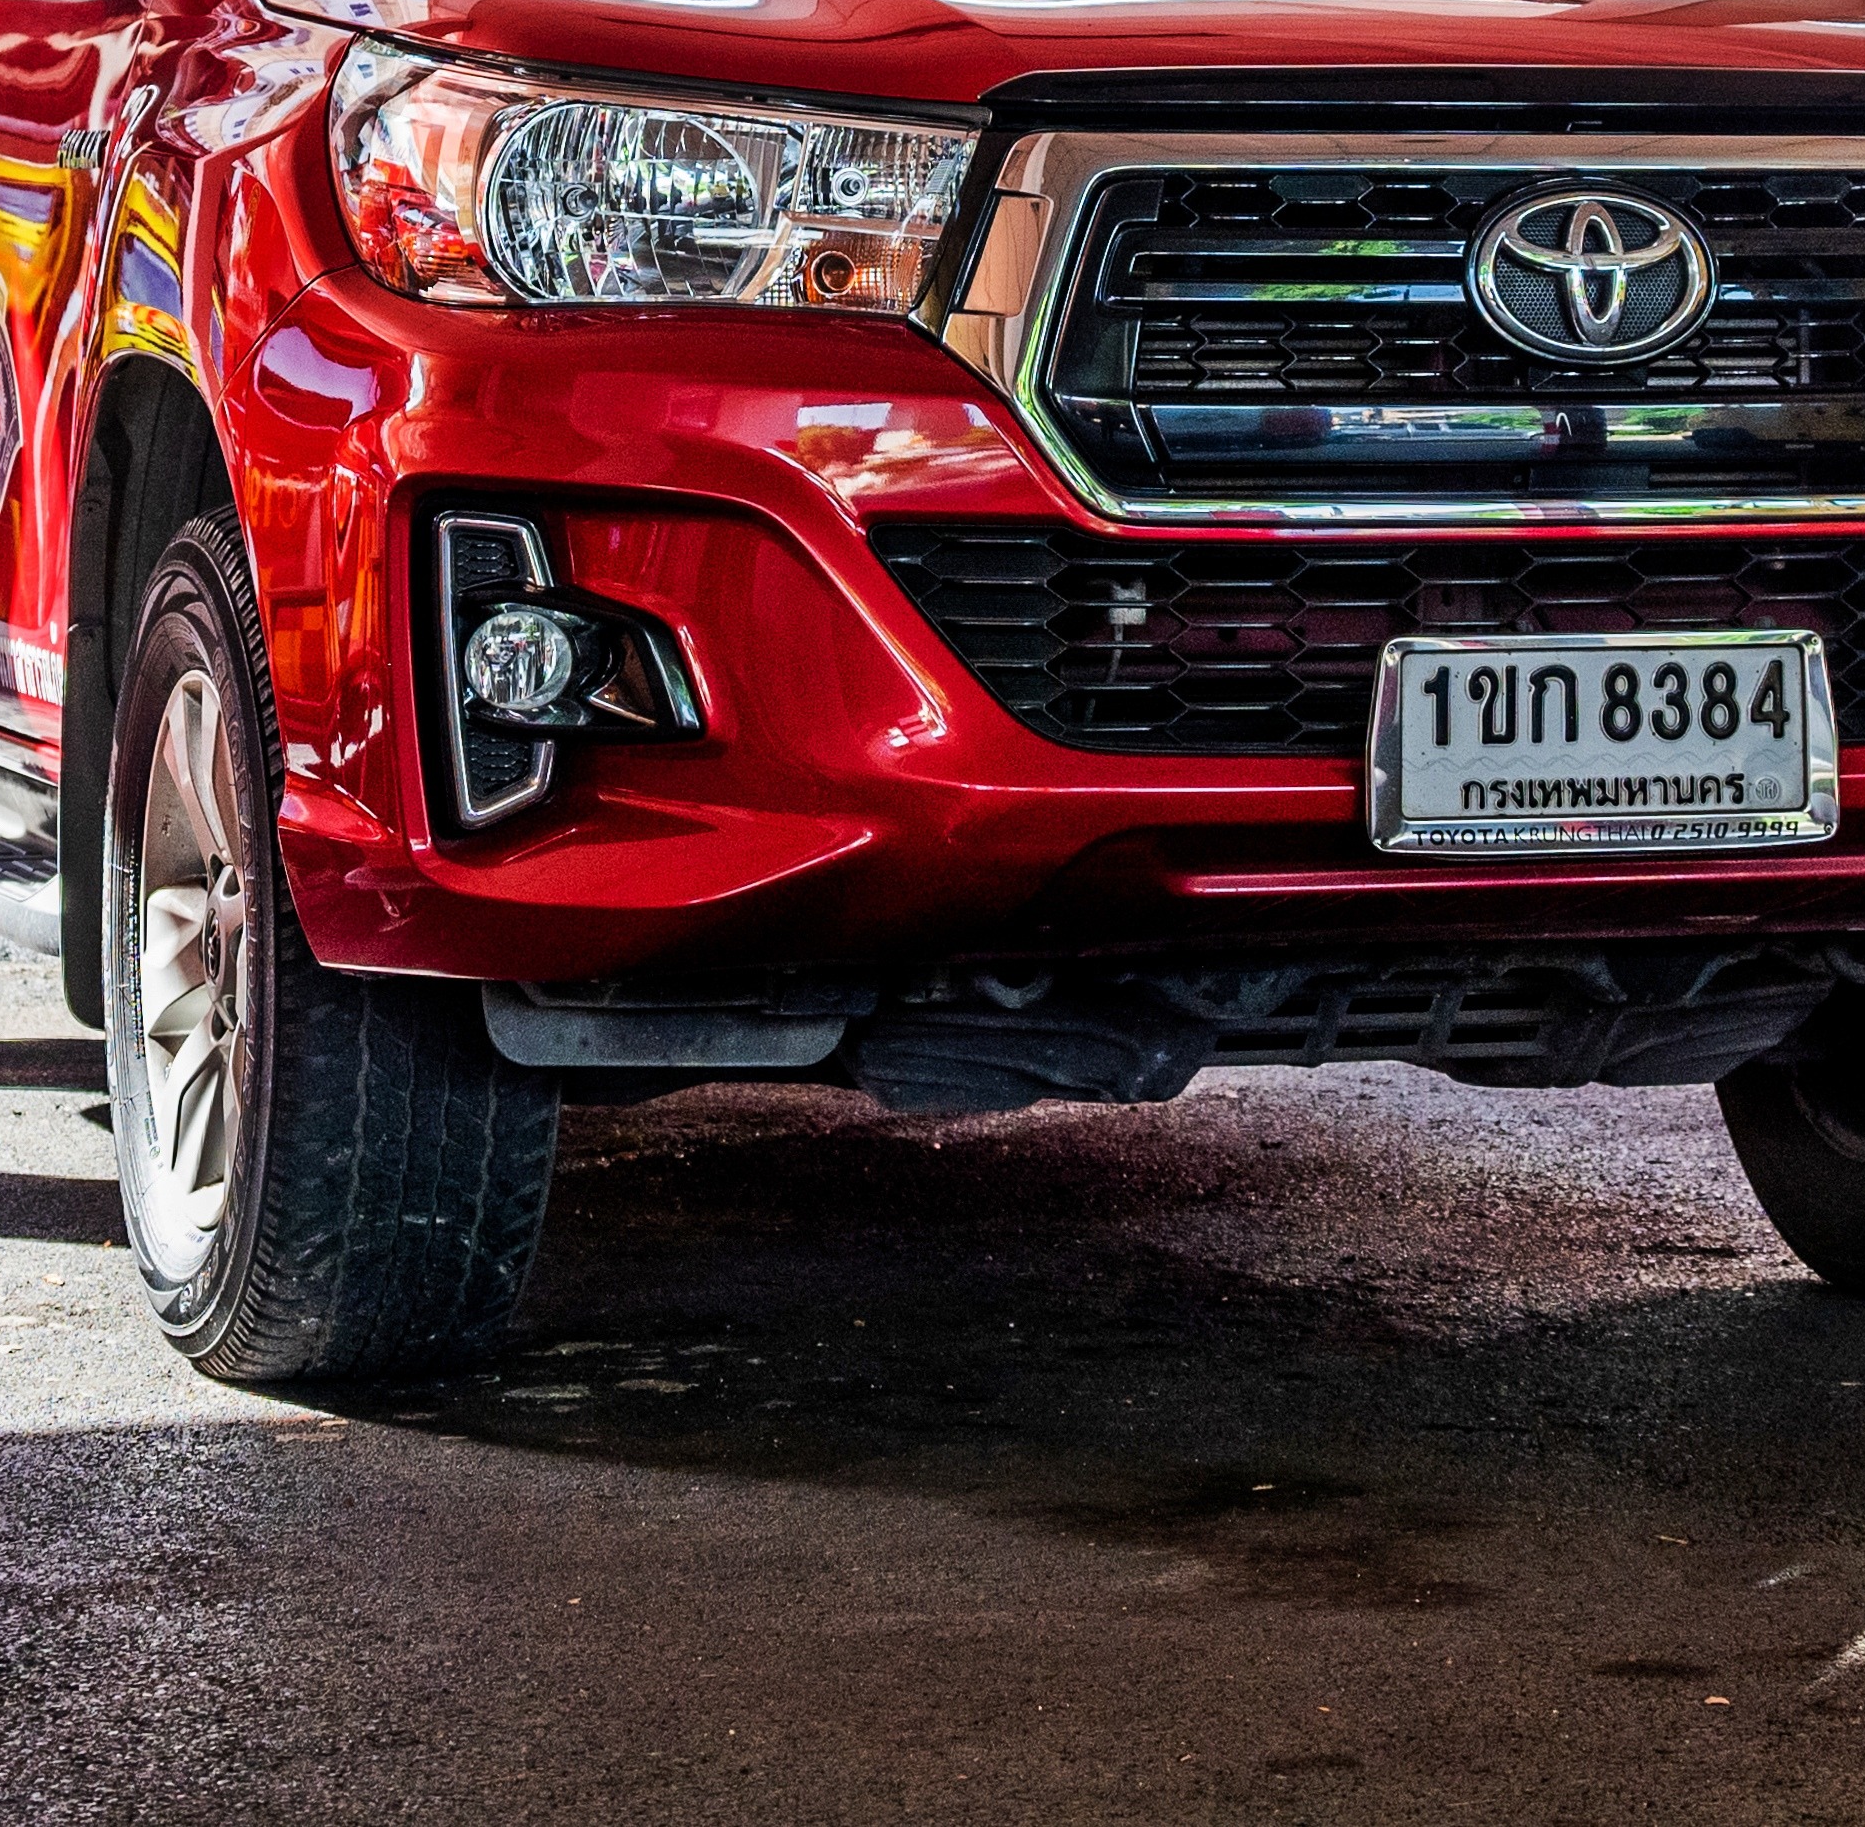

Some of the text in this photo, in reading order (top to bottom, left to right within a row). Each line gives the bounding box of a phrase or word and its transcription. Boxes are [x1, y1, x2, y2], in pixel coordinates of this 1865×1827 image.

[1422, 659, 1792, 748] 1ขก 8384
[1461, 772, 1745, 811] กรงเทพมหานคร
[1411, 827, 1509, 847] TOYOTA
[1512, 823, 1646, 844] KRUNGTHAI
